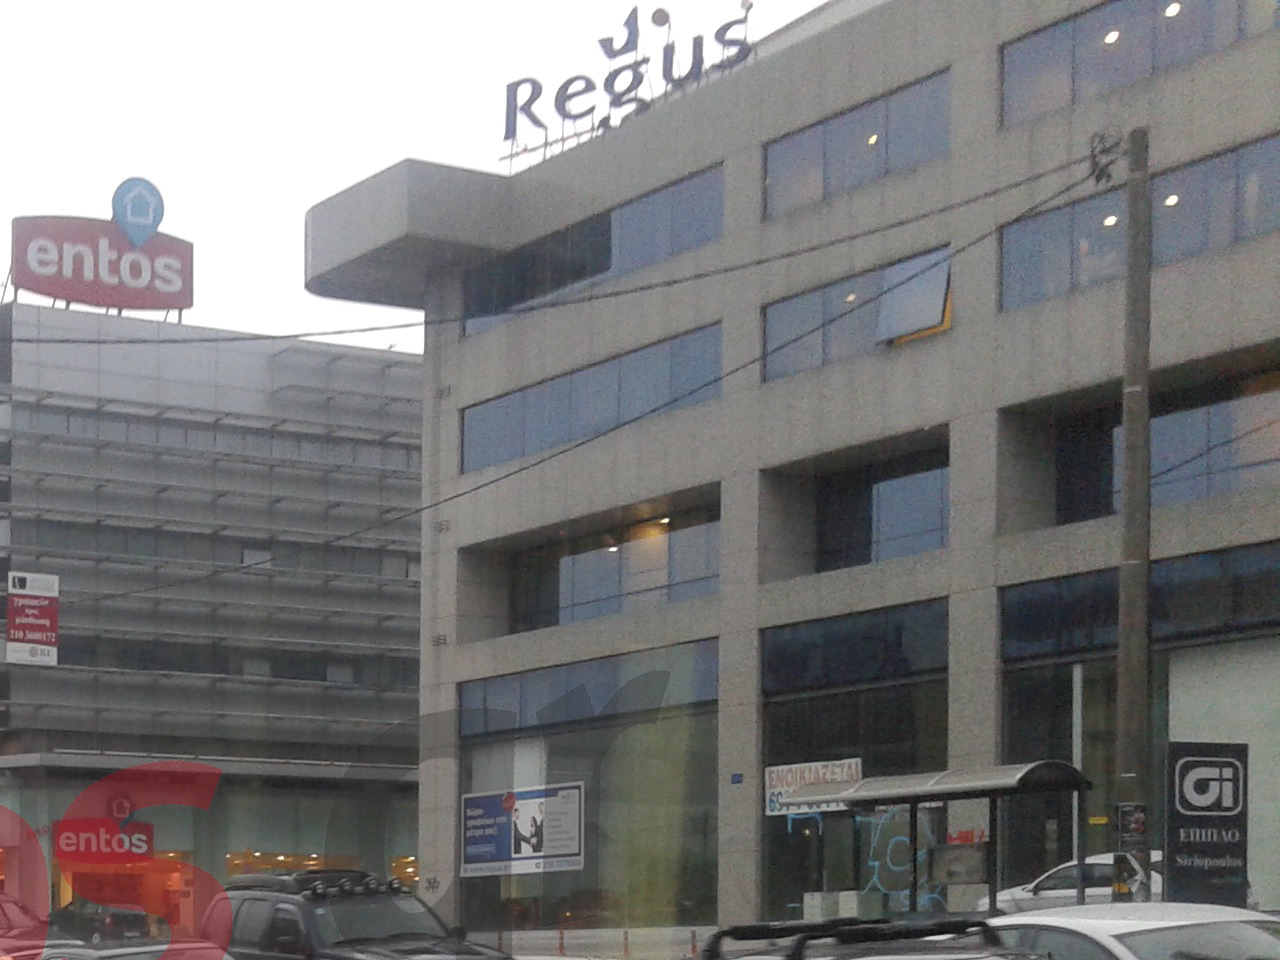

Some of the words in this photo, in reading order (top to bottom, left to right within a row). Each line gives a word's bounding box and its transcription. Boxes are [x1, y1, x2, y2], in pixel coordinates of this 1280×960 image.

[503, 16, 753, 142] Regus
[27, 236, 184, 293] entos
[59, 828, 148, 854] entos
[1179, 828, 1240, 843] ΕΠΙΠΛΟ
